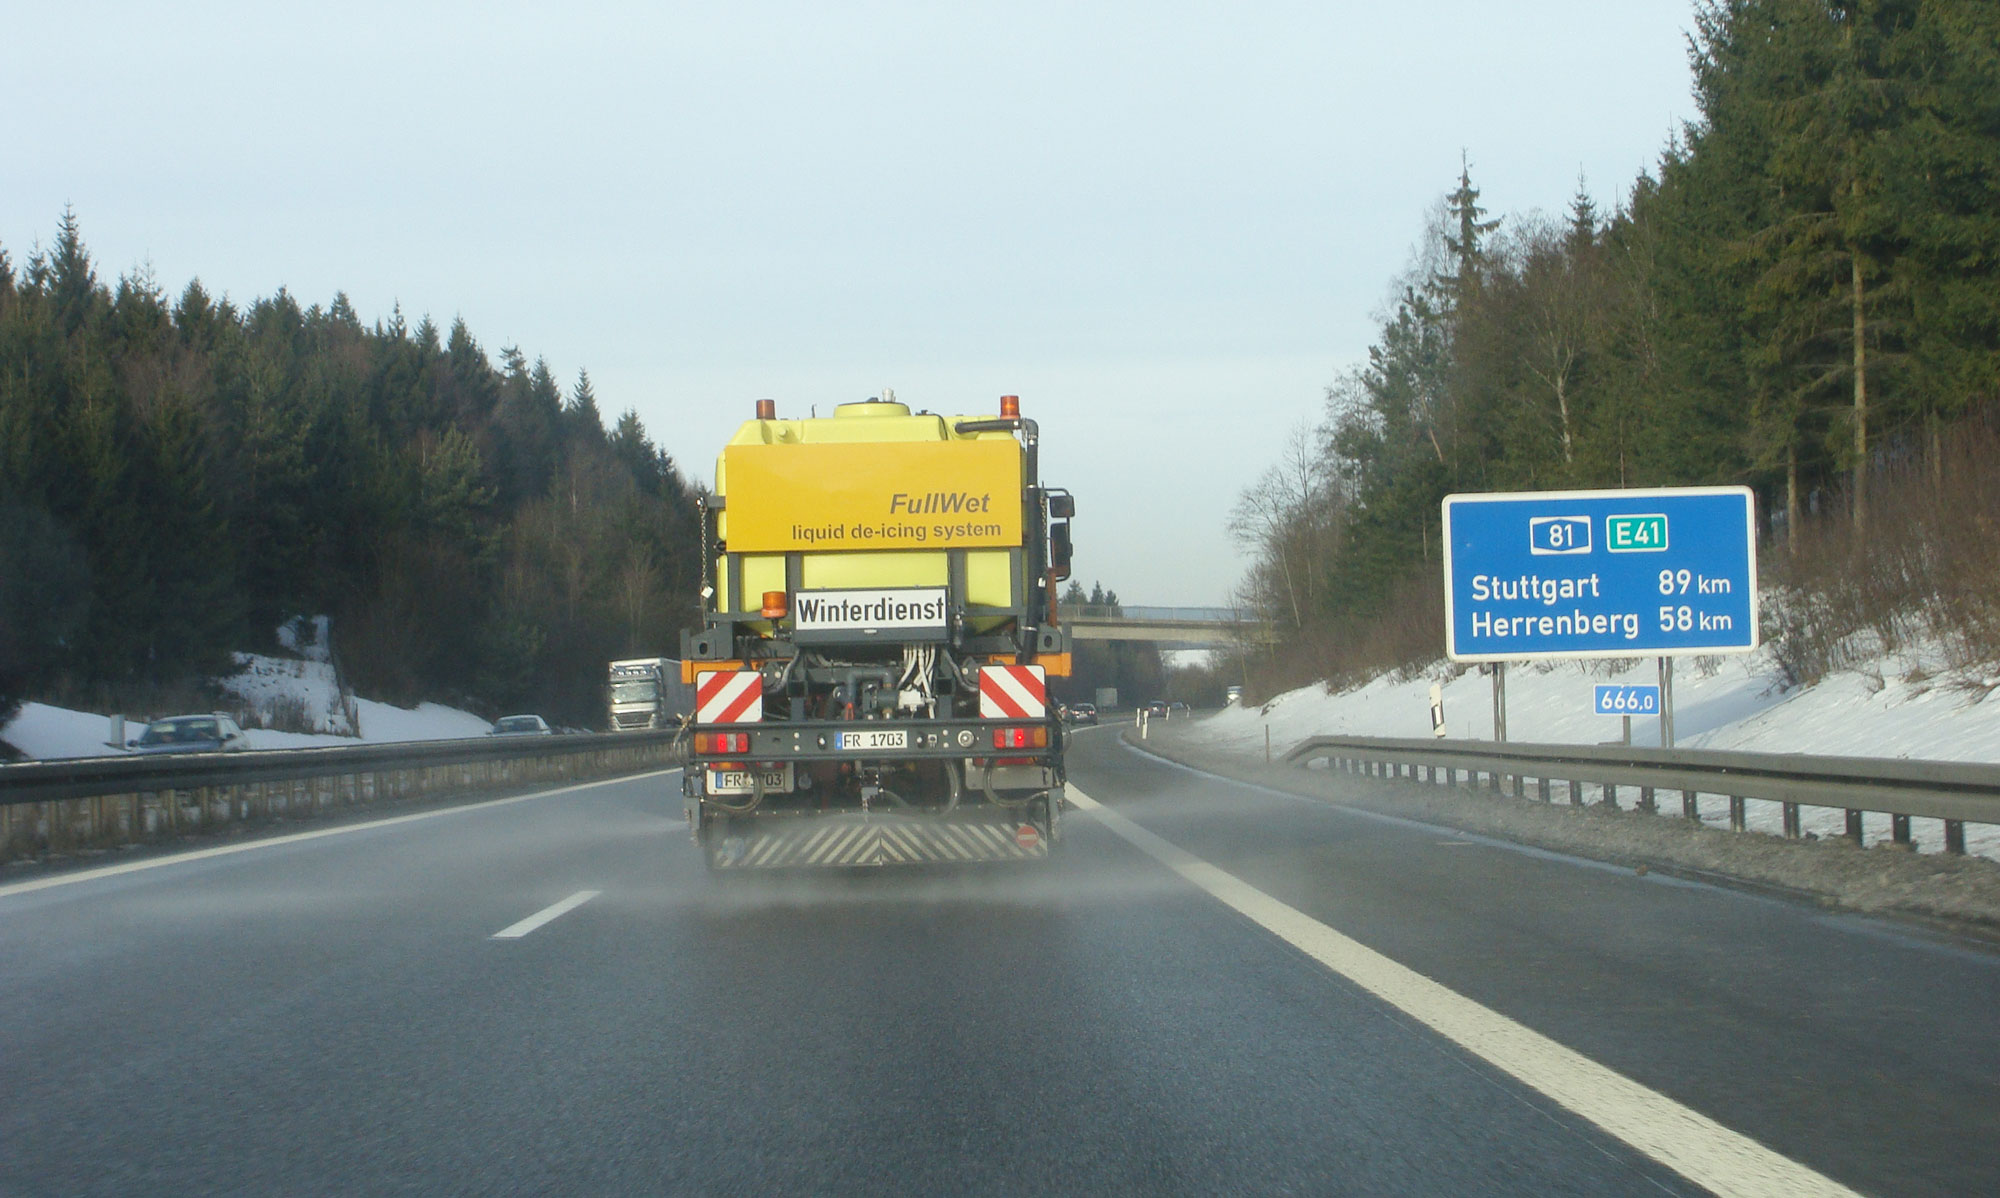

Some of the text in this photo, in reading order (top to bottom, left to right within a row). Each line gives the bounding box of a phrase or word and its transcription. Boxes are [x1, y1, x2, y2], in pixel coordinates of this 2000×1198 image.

[889, 492, 991, 514] FullWet
[792, 522, 1002, 543] liquid de-icing system
[1549, 523, 1574, 547] 81
[1616, 521, 1660, 546] E41
[1471, 569, 1732, 605] Stuttgart 89 km
[797, 596, 945, 623] Winterdienst
[1472, 605, 1733, 640] Herrenberg 58 km
[1600, 690, 1654, 711] 666,0
[842, 731, 904, 748] FR 1703
[724, 774, 742, 787] FR
